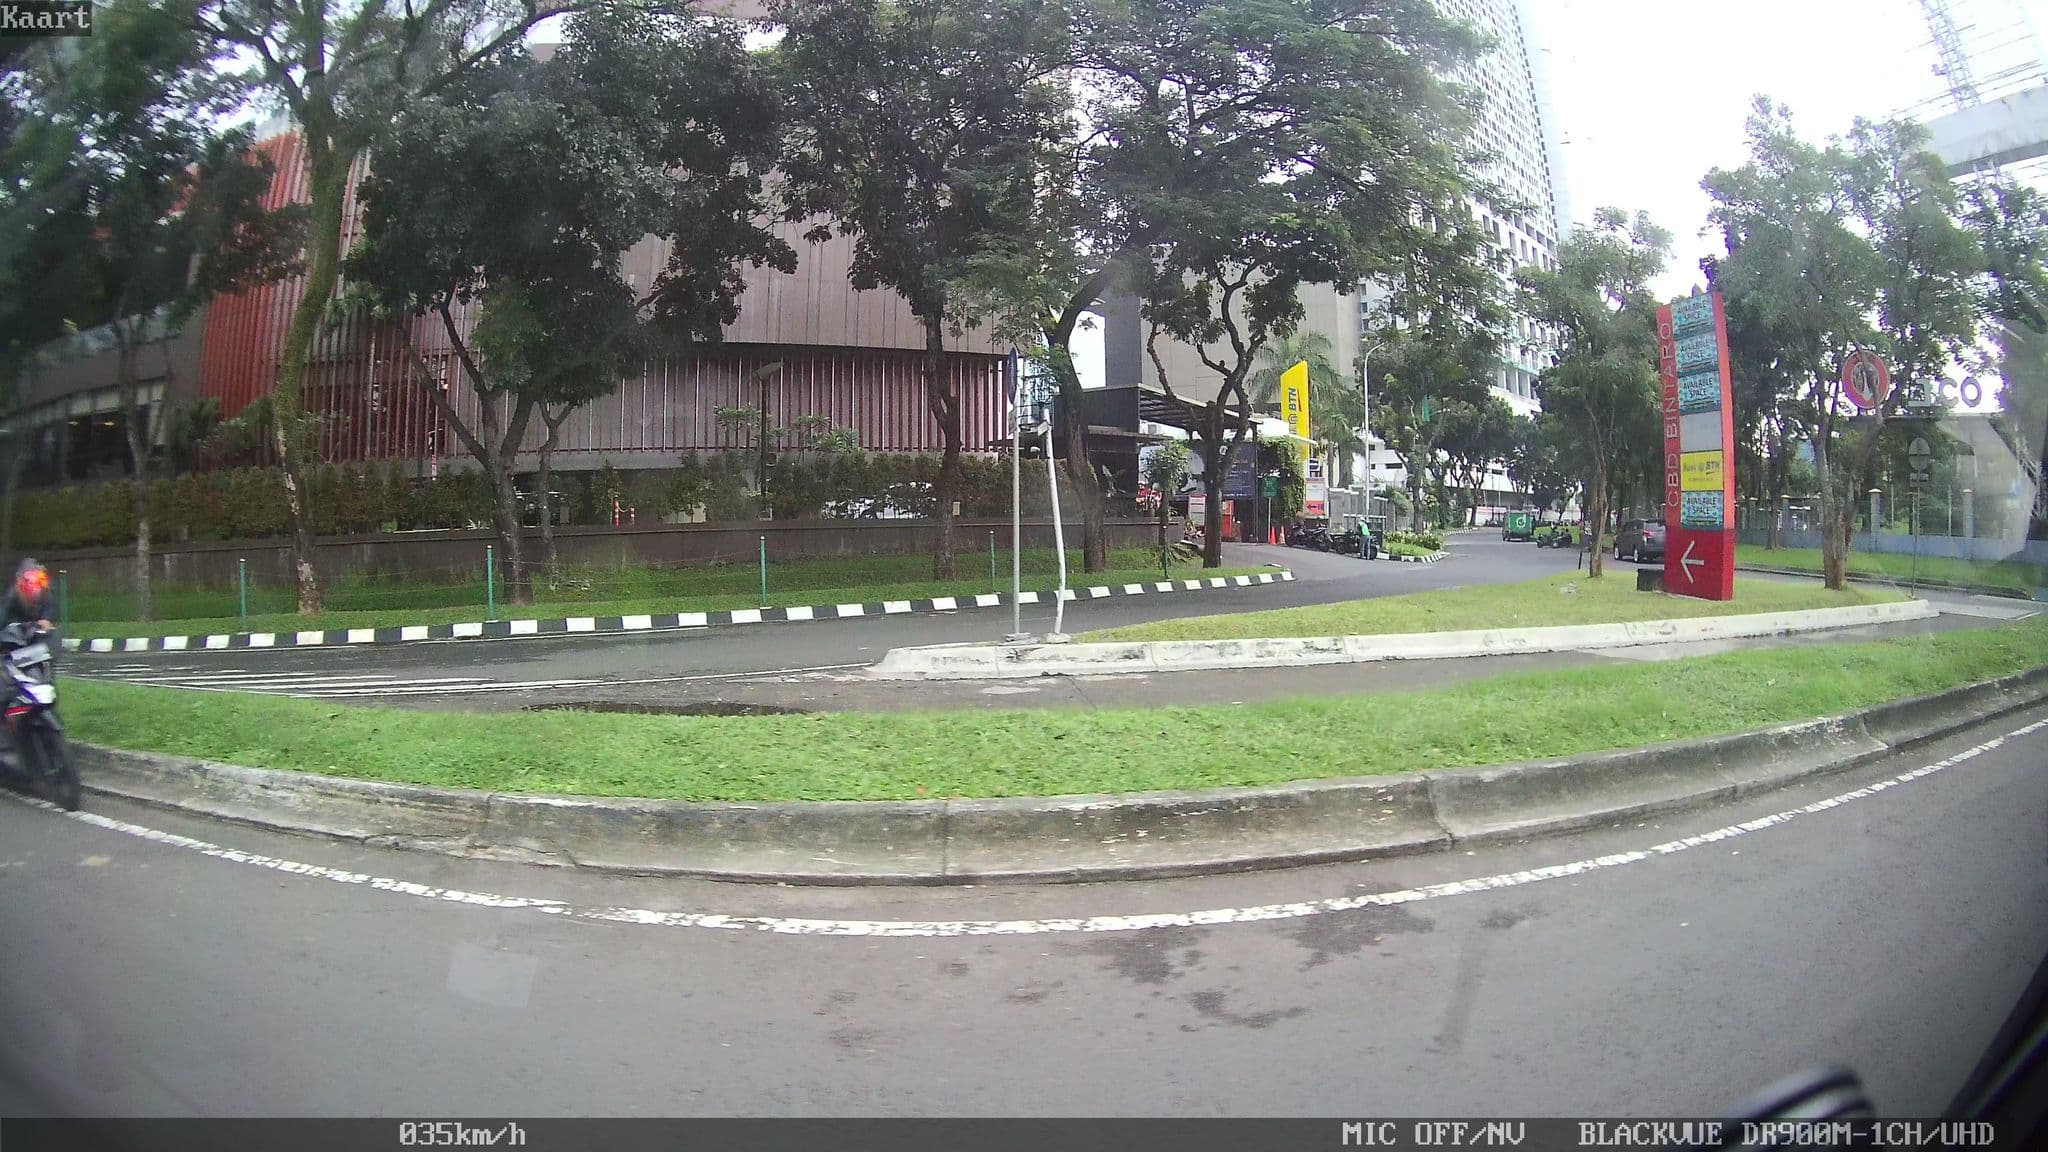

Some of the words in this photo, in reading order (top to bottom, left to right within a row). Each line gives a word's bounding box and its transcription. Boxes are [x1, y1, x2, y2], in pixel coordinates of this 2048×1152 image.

[1677, 299, 1708, 314] AVAILABLE
[1680, 339, 1711, 353] AVAILABLE
[1686, 349, 1705, 359] SPACE
[1660, 322, 1678, 438] BINTARO
[1683, 377, 1713, 389] AVAILABLE
[1288, 387, 1297, 411] BTN
[1689, 387, 1708, 398] SPACE
[1667, 453, 1679, 507] CBD
[1686, 497, 1717, 507] AVAILABLE
[1692, 505, 1711, 515] SPACE
